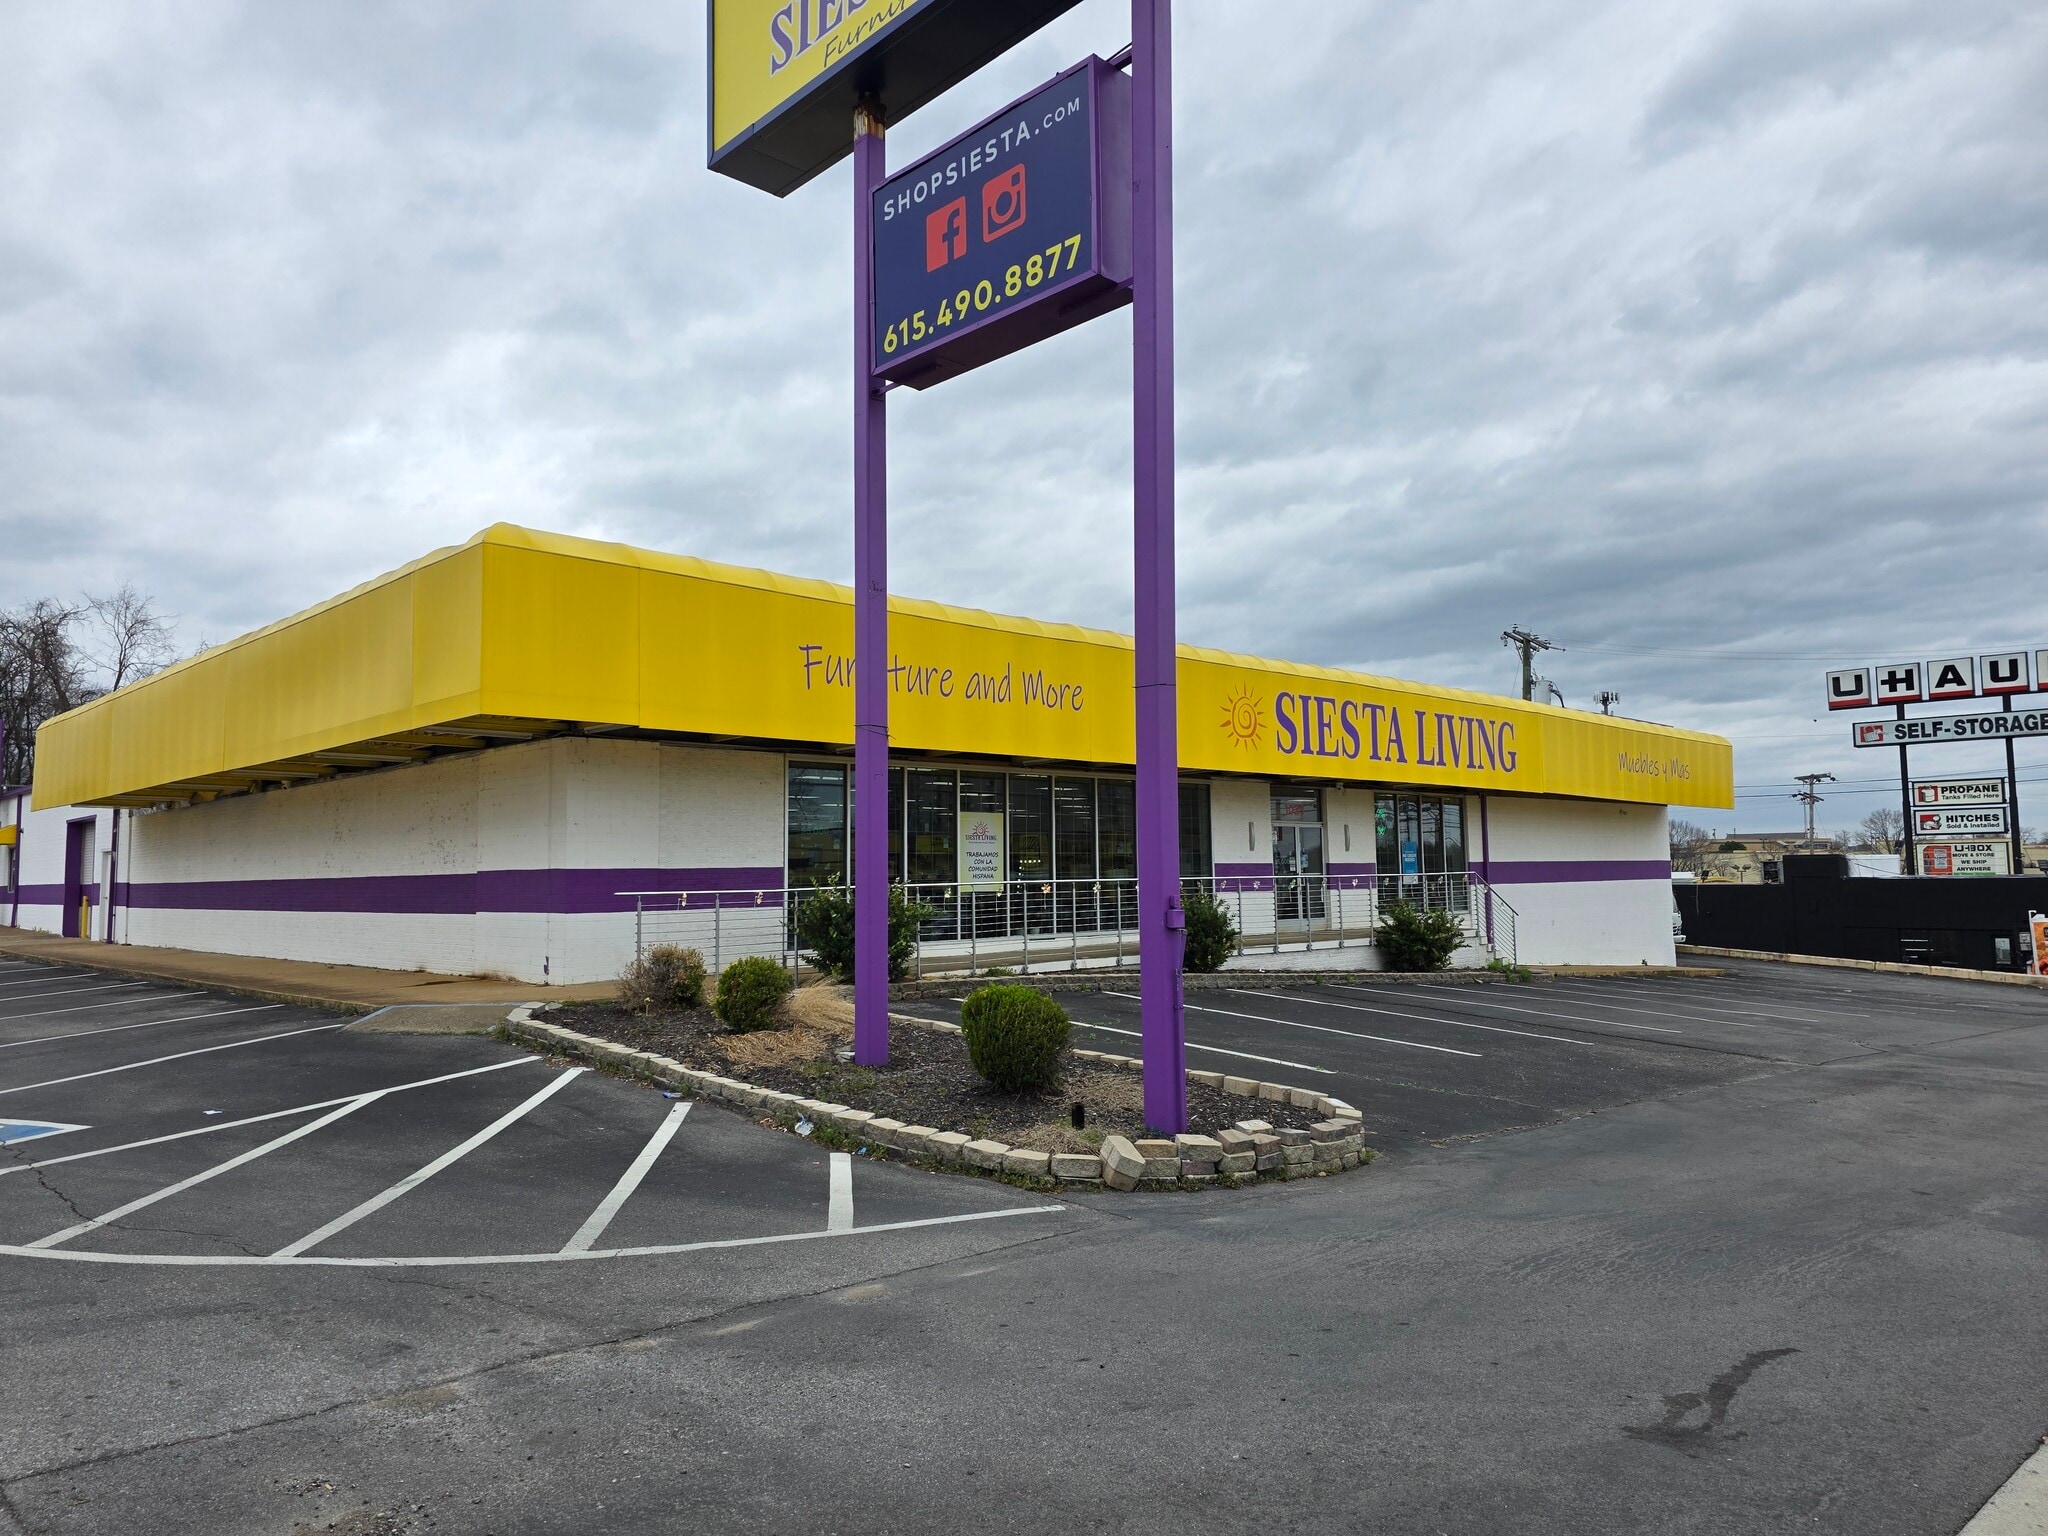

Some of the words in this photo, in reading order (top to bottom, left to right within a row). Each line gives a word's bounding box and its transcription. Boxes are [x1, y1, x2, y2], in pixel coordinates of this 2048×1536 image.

[771, 0, 867, 76] SIE
[883, 96, 1081, 221] SHOPSIESTA.COM
[883, 233, 1082, 354] 615.490.8877
[798, 643, 954, 698] Furture
[964, 662, 1012, 704] and
[1022, 668, 1084, 712] More
[1274, 691, 1408, 764] SIESTA
[1414, 709, 1518, 774] LIVING
[1894, 713, 2048, 740] SELF-STORAGE
[1618, 751, 1660, 777] Muebles
[1661, 762, 1668, 782] y
[1670, 757, 1690, 780] Mas
[1941, 784, 1999, 794] PROPANE
[1946, 814, 2000, 823] HITCHES
